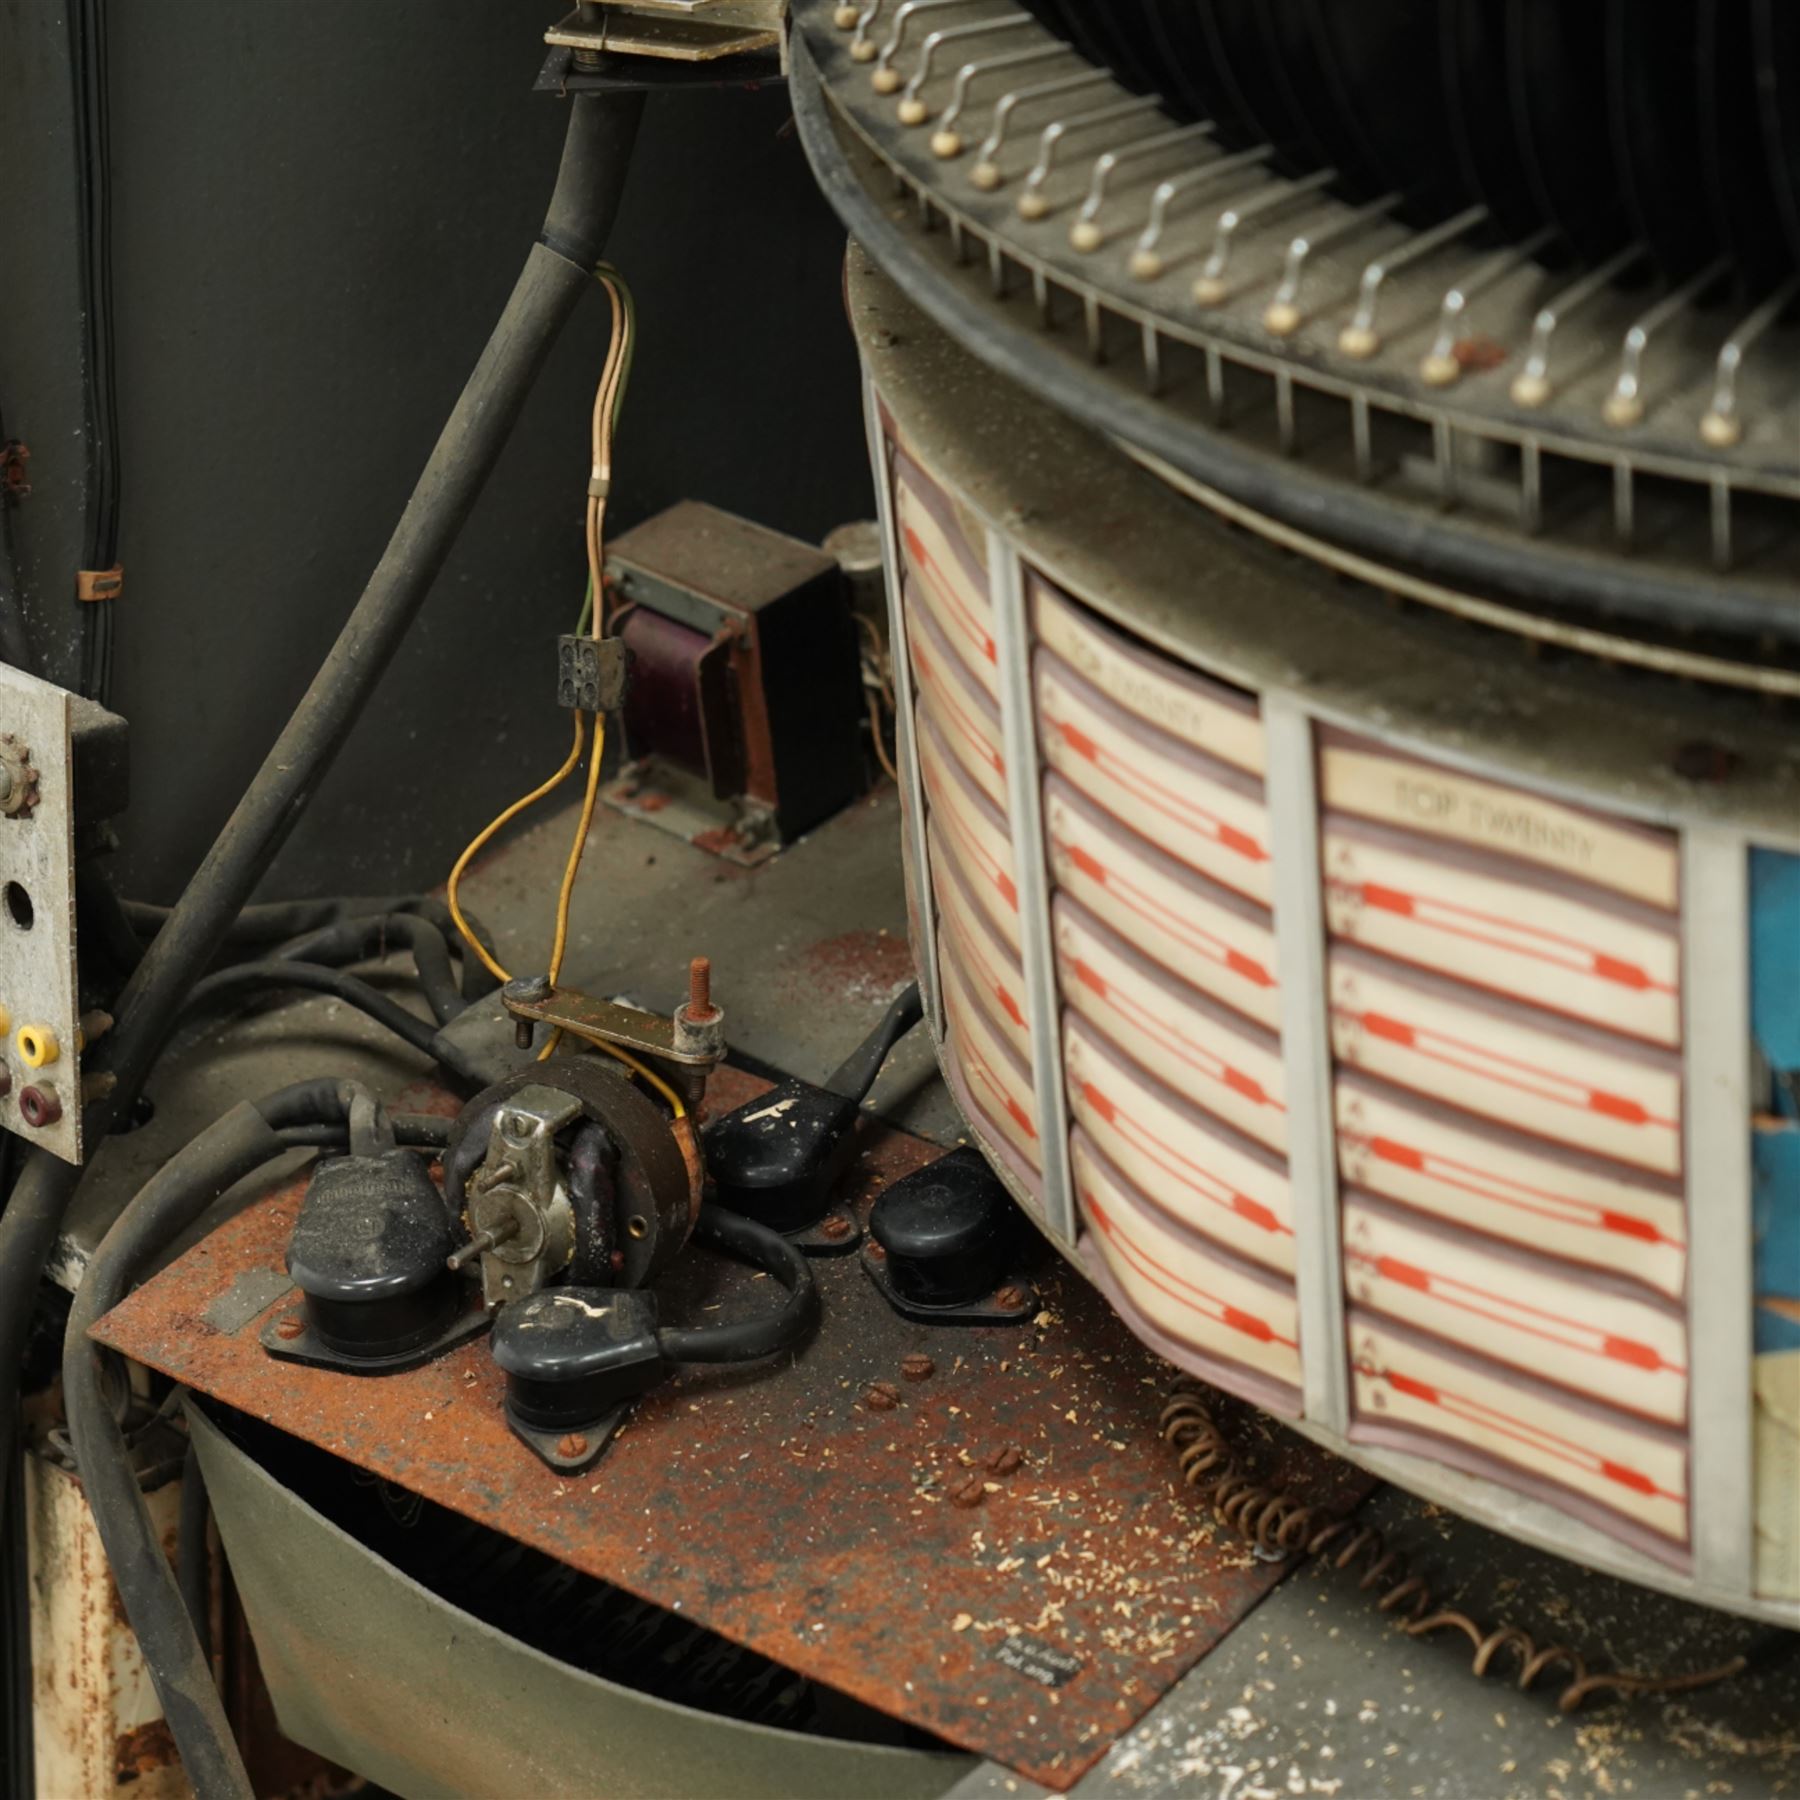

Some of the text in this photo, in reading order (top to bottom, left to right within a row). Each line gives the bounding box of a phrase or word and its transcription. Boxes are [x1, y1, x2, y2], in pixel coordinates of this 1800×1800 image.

[1394, 779, 1597, 863] TOP TWENTY
[1373, 1390, 1386, 1408] B
